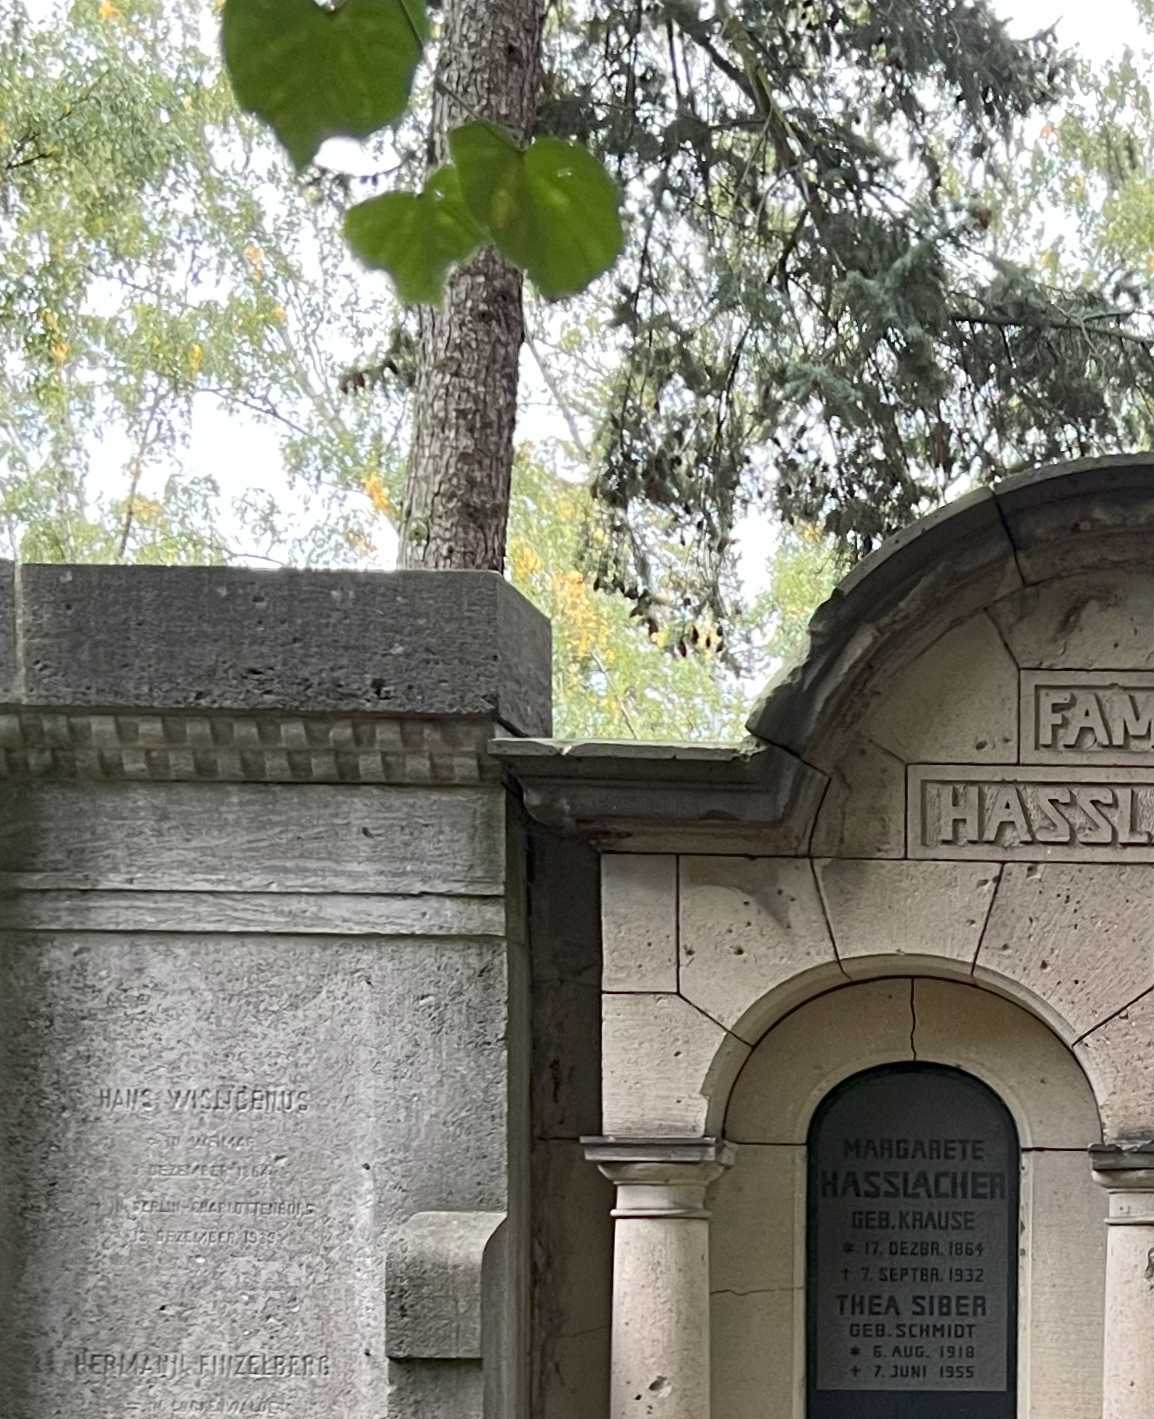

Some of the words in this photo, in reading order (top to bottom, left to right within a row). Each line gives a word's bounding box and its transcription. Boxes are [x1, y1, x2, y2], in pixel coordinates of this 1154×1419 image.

[98, 1088, 155, 1111] HANS
[842, 1138, 985, 1161] MARGARETE
[820, 1170, 1005, 1199] HASSLACHER
[851, 1210, 895, 1231] GEB.
[898, 1210, 975, 1231] KRAUSE
[864, 1241, 882, 1256] 17.
[888, 1241, 944, 1256] DEZBR.
[948, 1241, 985, 1256] 1864
[861, 1268, 872, 1283] 7.
[879, 1268, 943, 1283] SEPTBR.
[949, 1268, 985, 1283] 1932
[835, 1294, 900, 1316] THEA
[911, 1295, 987, 1317] SIBER
[849, 1323, 891, 1339] GEB.
[895, 1323, 977, 1339] SCHMIDT
[892, 1345, 930, 1359] AUG.
[939, 1345, 975, 1359] 1918
[873, 1365, 885, 1378] 7.
[890, 1365, 927, 1379] JUNI
[939, 1365, 975, 1379] 1955
